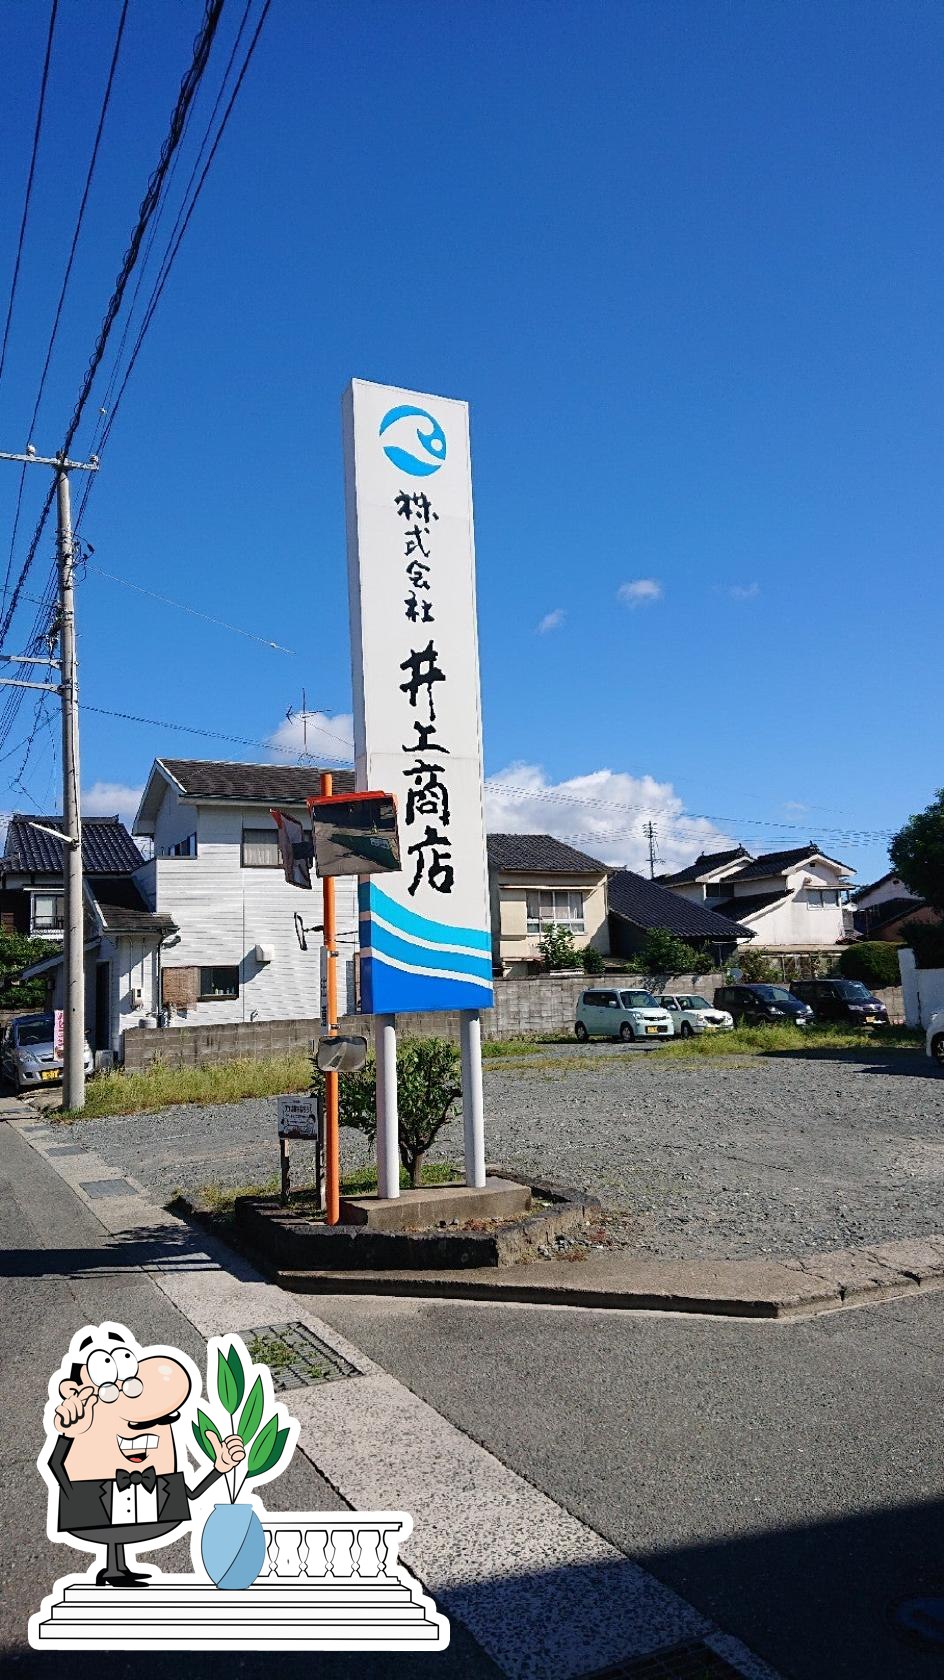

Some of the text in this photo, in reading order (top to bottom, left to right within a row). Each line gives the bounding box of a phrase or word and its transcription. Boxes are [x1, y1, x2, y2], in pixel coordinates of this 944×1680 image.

[394, 489, 455, 897] 株式会社 井上商店
